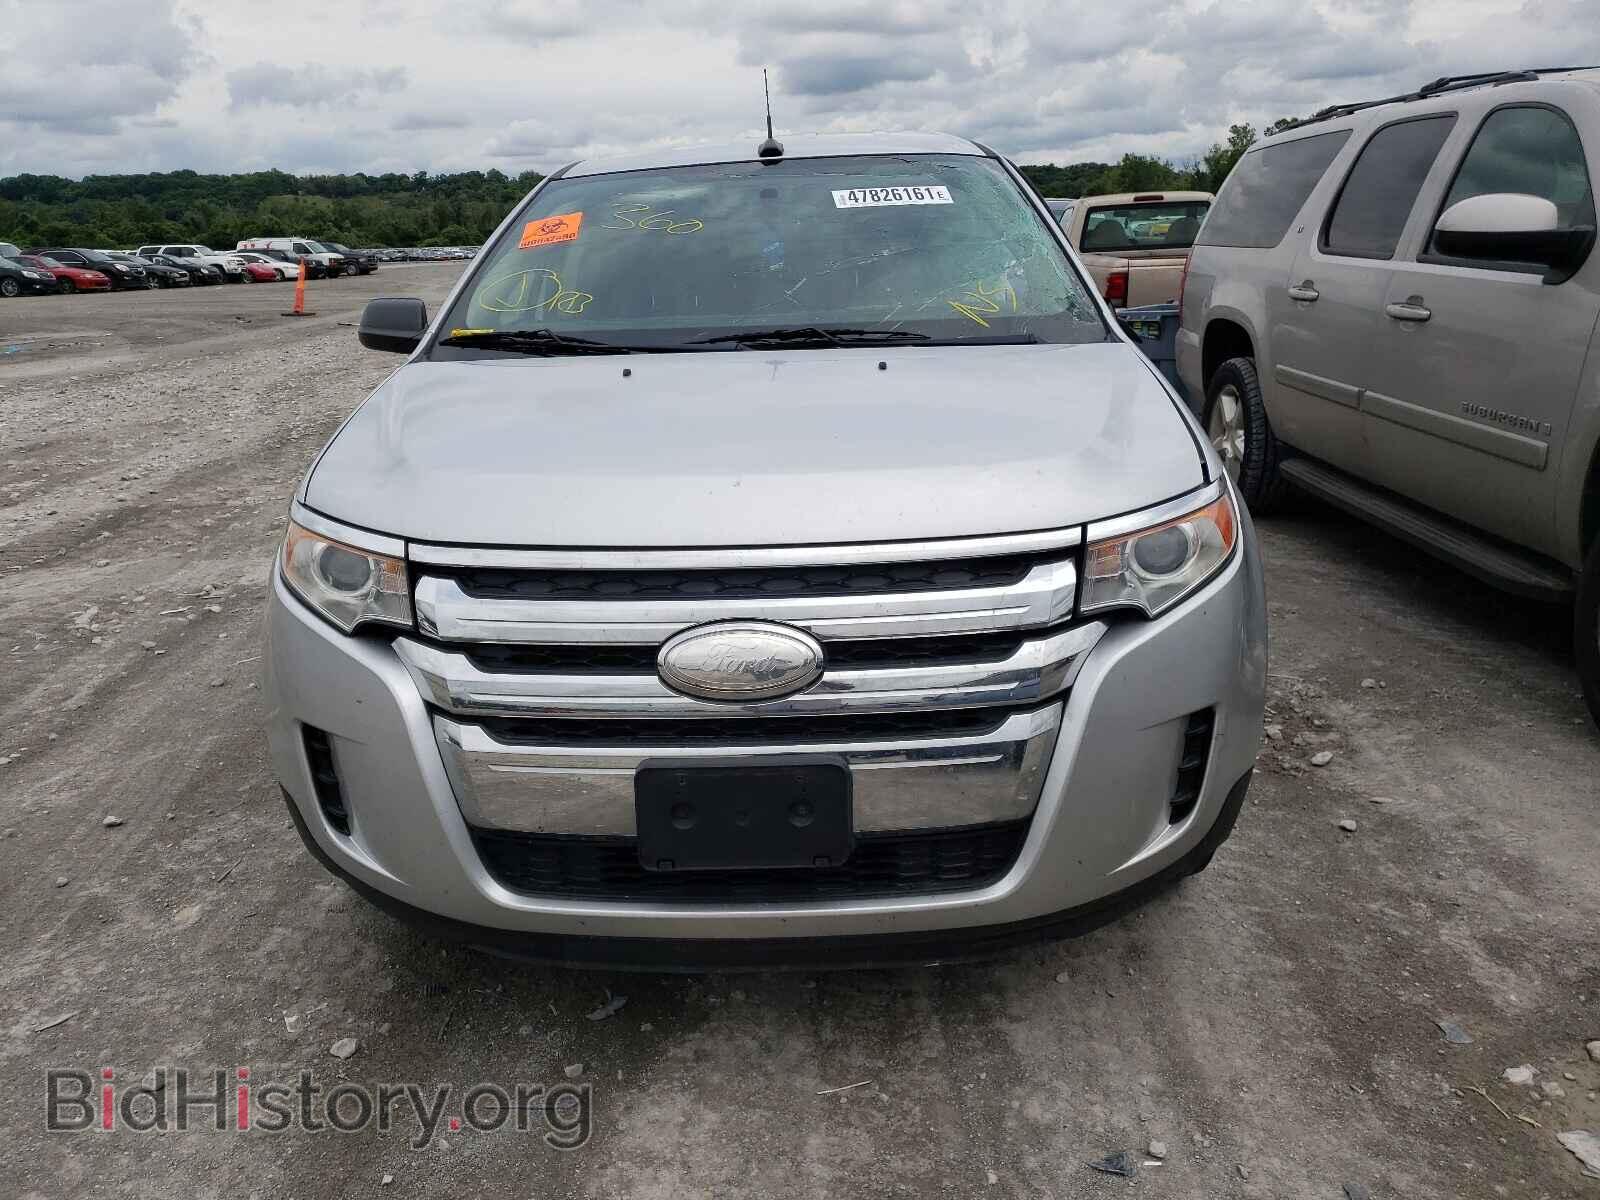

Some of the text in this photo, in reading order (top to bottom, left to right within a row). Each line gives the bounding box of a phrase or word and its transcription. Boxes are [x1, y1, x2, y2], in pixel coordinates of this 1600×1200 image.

[848, 187, 935, 203] 47826161
[1461, 401, 1541, 433] SUBURBAN
[701, 643, 779, 675] Ford
